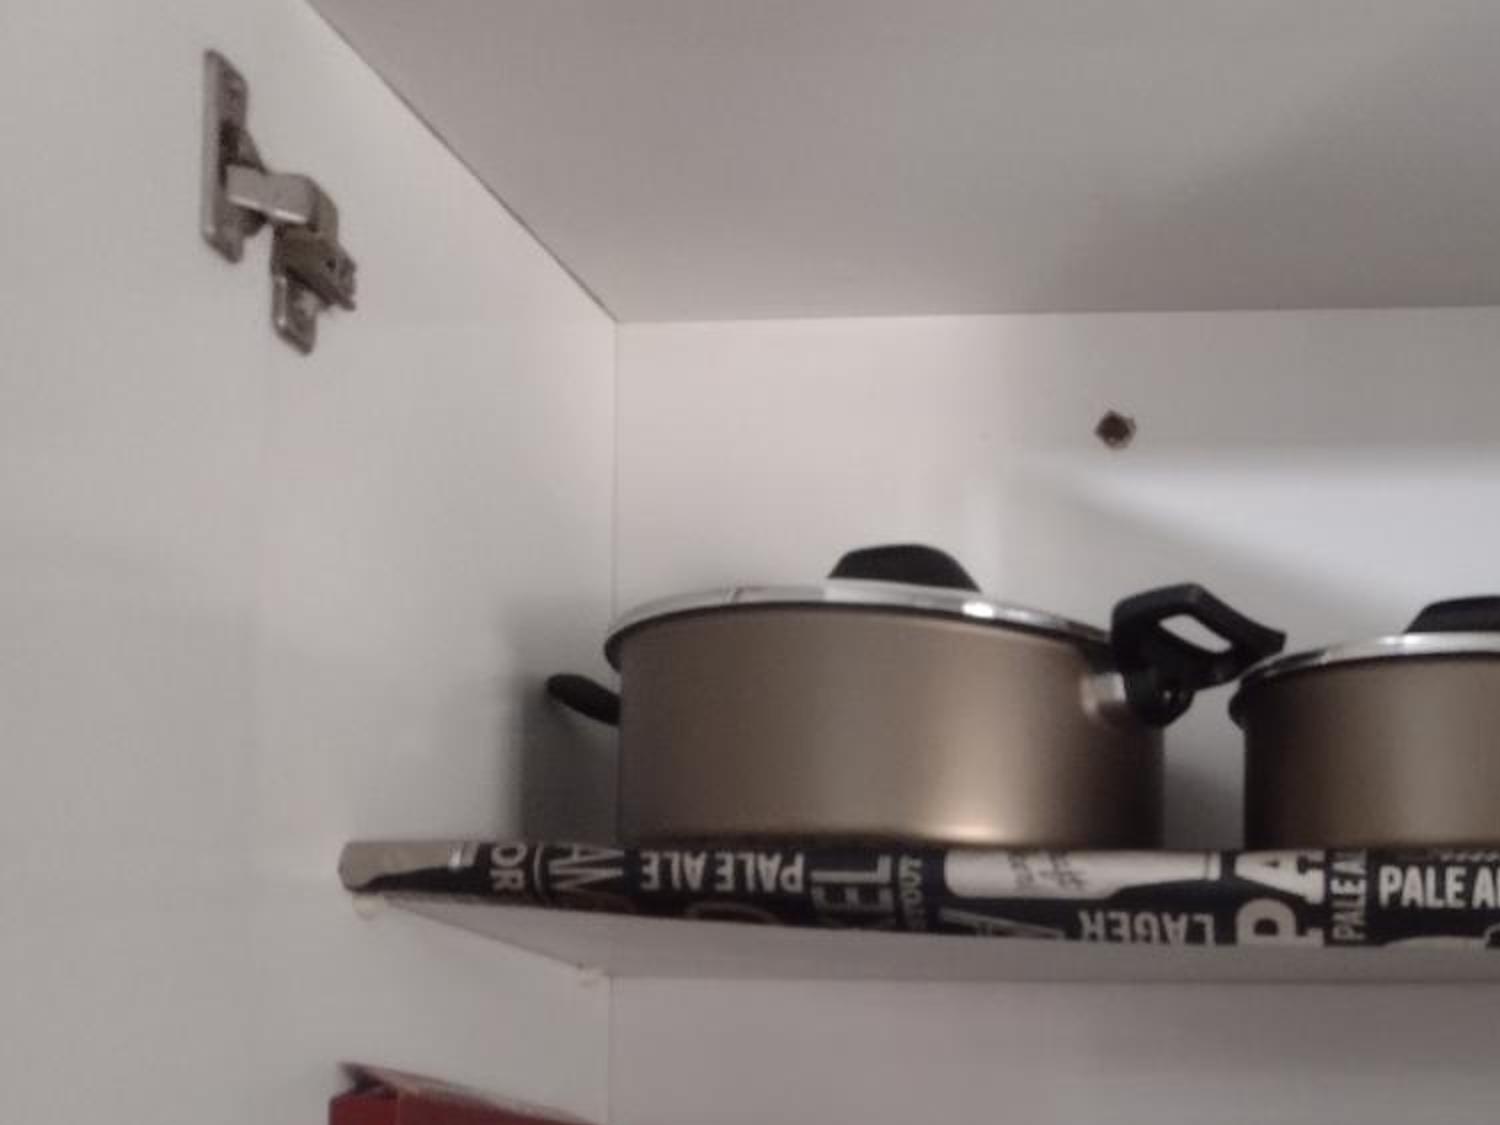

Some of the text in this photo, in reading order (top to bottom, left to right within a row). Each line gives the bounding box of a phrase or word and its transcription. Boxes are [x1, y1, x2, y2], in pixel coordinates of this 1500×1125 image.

[640, 850, 804, 893] PALE ALE
[1378, 864, 1468, 910] PALE
